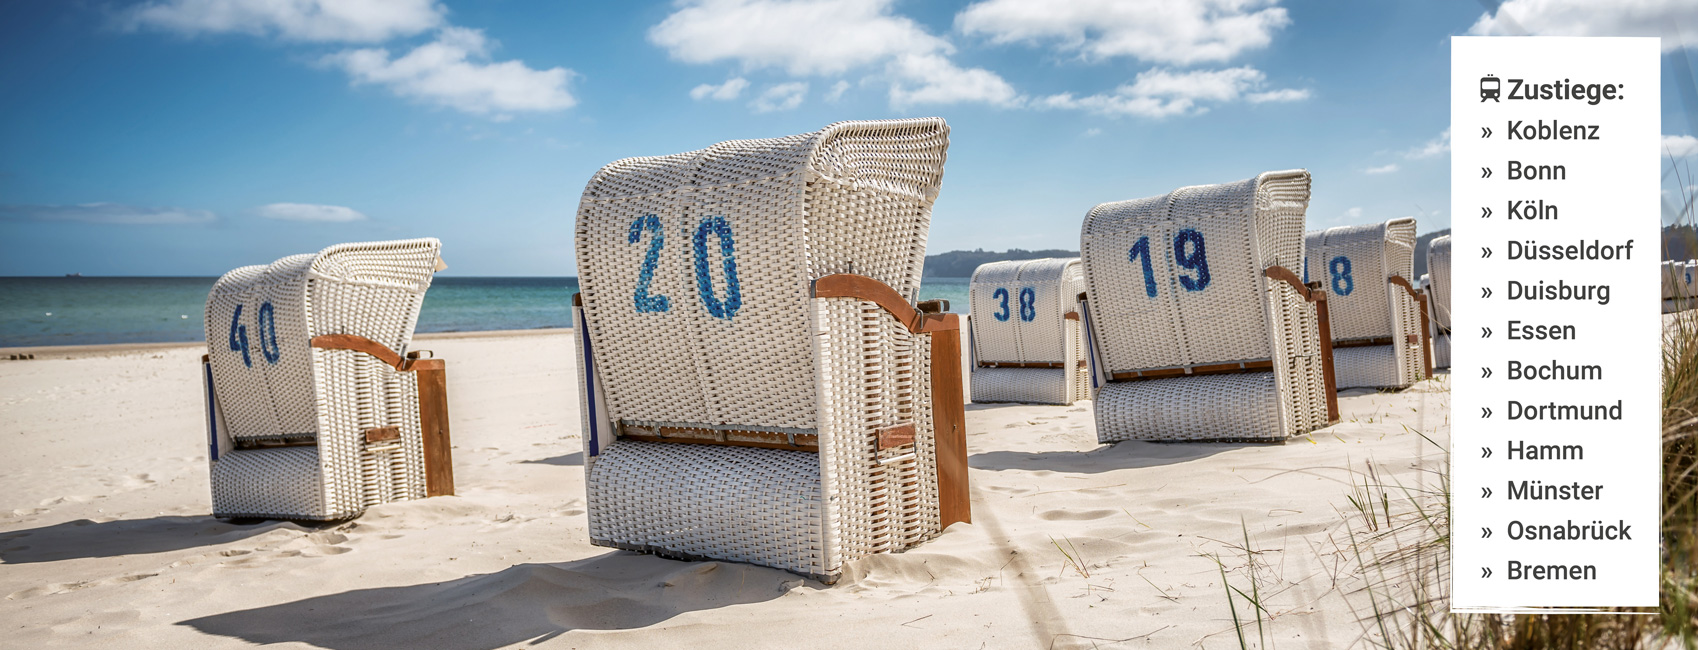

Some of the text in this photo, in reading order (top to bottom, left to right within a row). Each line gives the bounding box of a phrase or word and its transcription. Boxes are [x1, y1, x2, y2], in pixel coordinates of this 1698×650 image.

[628, 213, 742, 320] 20
[1128, 227, 1211, 298] 19
[229, 302, 280, 368] 40
[992, 287, 1036, 322] 38
